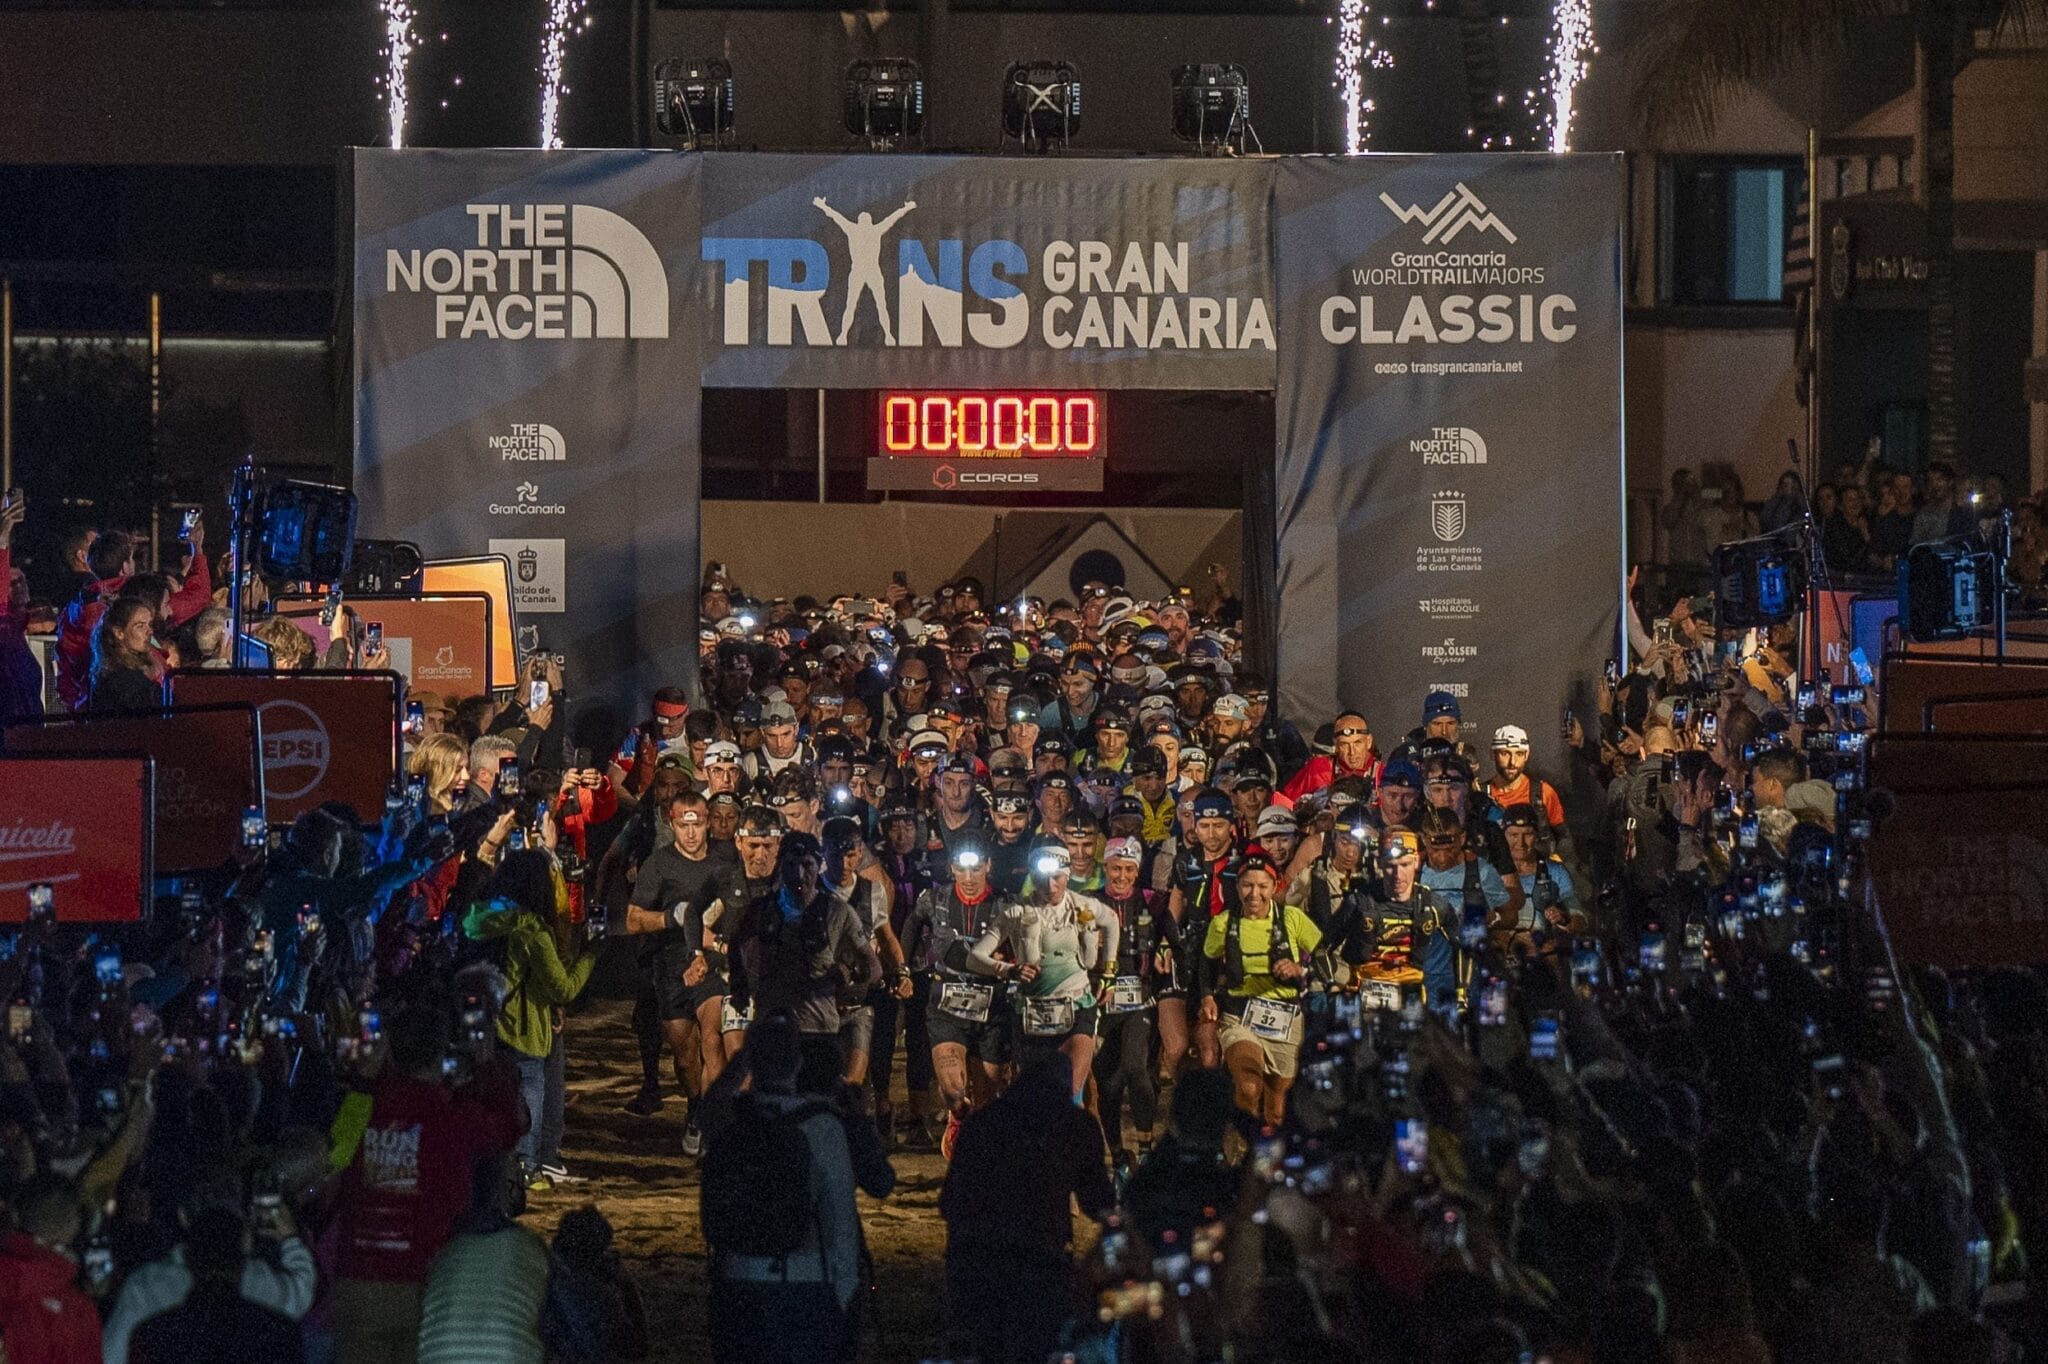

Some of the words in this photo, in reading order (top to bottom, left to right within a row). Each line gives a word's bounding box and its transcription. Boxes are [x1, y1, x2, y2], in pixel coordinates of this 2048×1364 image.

[466, 204, 566, 247] THE
[1391, 251, 1506, 268] GranCanaria
[386, 248, 566, 293] NORTH
[1042, 241, 1189, 295] GRAN
[1352, 268, 1545, 286] WORLDTRAILMAJORS
[435, 294, 566, 340] FACE
[1320, 294, 1578, 344] CLASSIC
[1042, 297, 1277, 350] CANARIA
[1411, 360, 1523, 376] transgrancanaria.net
[511, 424, 538, 435] THE
[886, 397, 1094, 451] 00:00:00
[1432, 427, 1459, 439] THE
[489, 436, 538, 448] NORTH
[1410, 440, 1459, 452] NORTH
[502, 448, 538, 460] FACE
[1423, 452, 1459, 465] FACE
[960, 473, 1039, 483] COROS
[489, 503, 566, 515] GranCanaria
[1416, 547, 1482, 556] Ayuntamiento
[1416, 555, 1428, 563] de
[1432, 555, 1447, 563] Las
[1450, 555, 1482, 563] Palmas
[1416, 563, 1428, 571] de
[1428, 564, 1449, 572] Gran
[539, 586, 550, 595] de
[521, 595, 557, 604] Canaria
[1431, 604, 1449, 612] SAN
[1450, 604, 1480, 612] ROQUE
[264, 739, 322, 759] EPSI
[1260, 1014, 1277, 1027] 32
